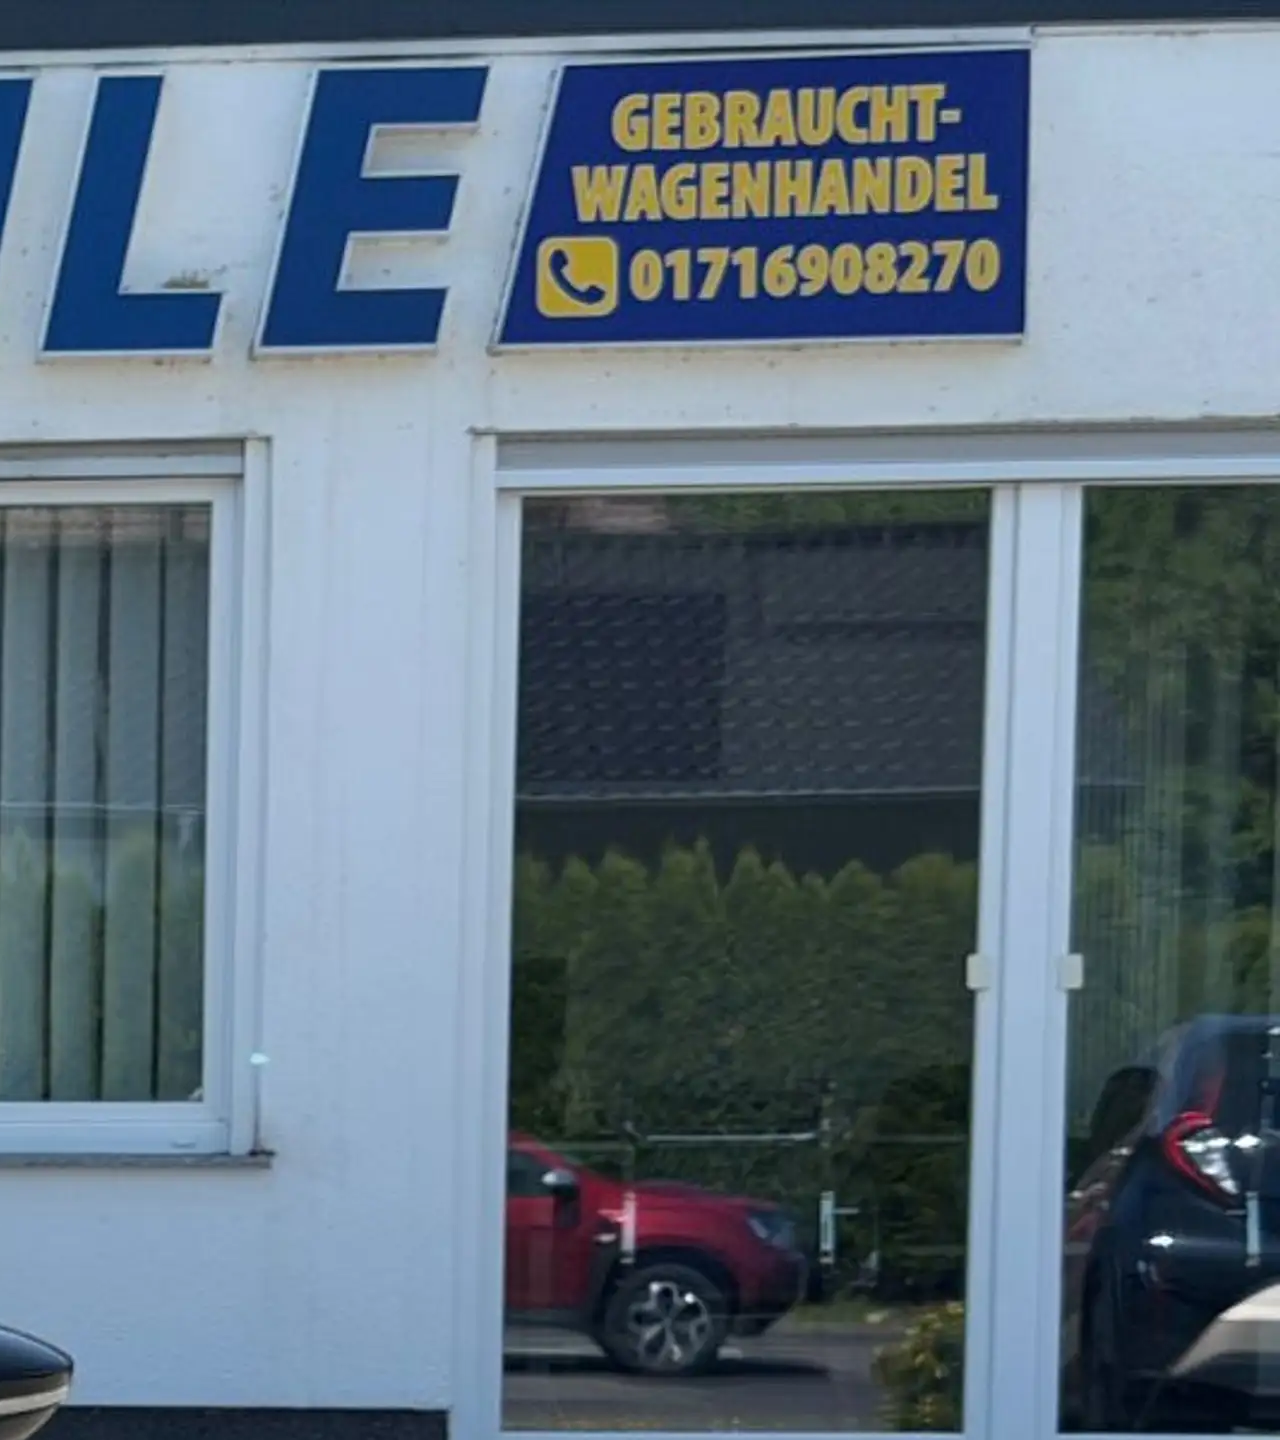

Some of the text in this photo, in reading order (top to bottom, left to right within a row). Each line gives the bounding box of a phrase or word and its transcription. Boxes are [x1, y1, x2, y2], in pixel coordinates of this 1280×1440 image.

[611, 83, 962, 152] GEBRAUCHT-
[571, 153, 999, 222] WAGENHANDEL
[629, 239, 1001, 301] 01716908270
